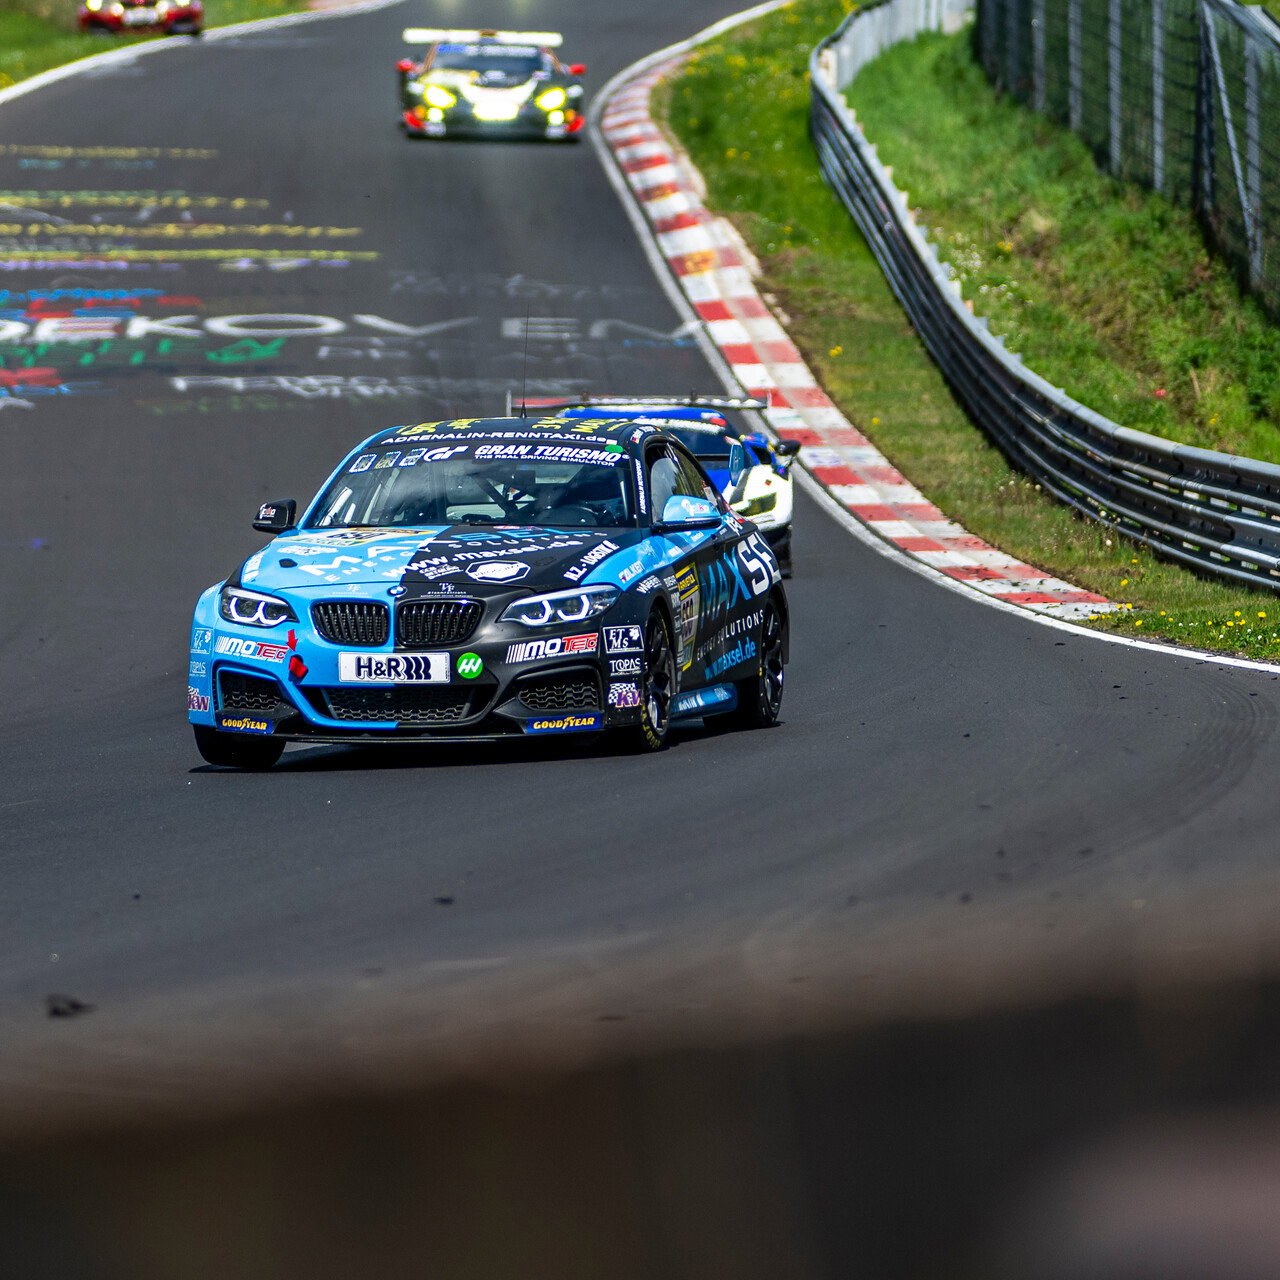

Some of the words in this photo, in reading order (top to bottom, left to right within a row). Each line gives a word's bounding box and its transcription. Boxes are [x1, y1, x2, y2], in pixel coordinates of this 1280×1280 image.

[475, 444, 533, 455] GRAN
[560, 456, 616, 468] SIMULATOR
[523, 632, 599, 656] MOTEC
[221, 717, 268, 730] GOODYEAR
[533, 716, 595, 730] GOODYEAR
